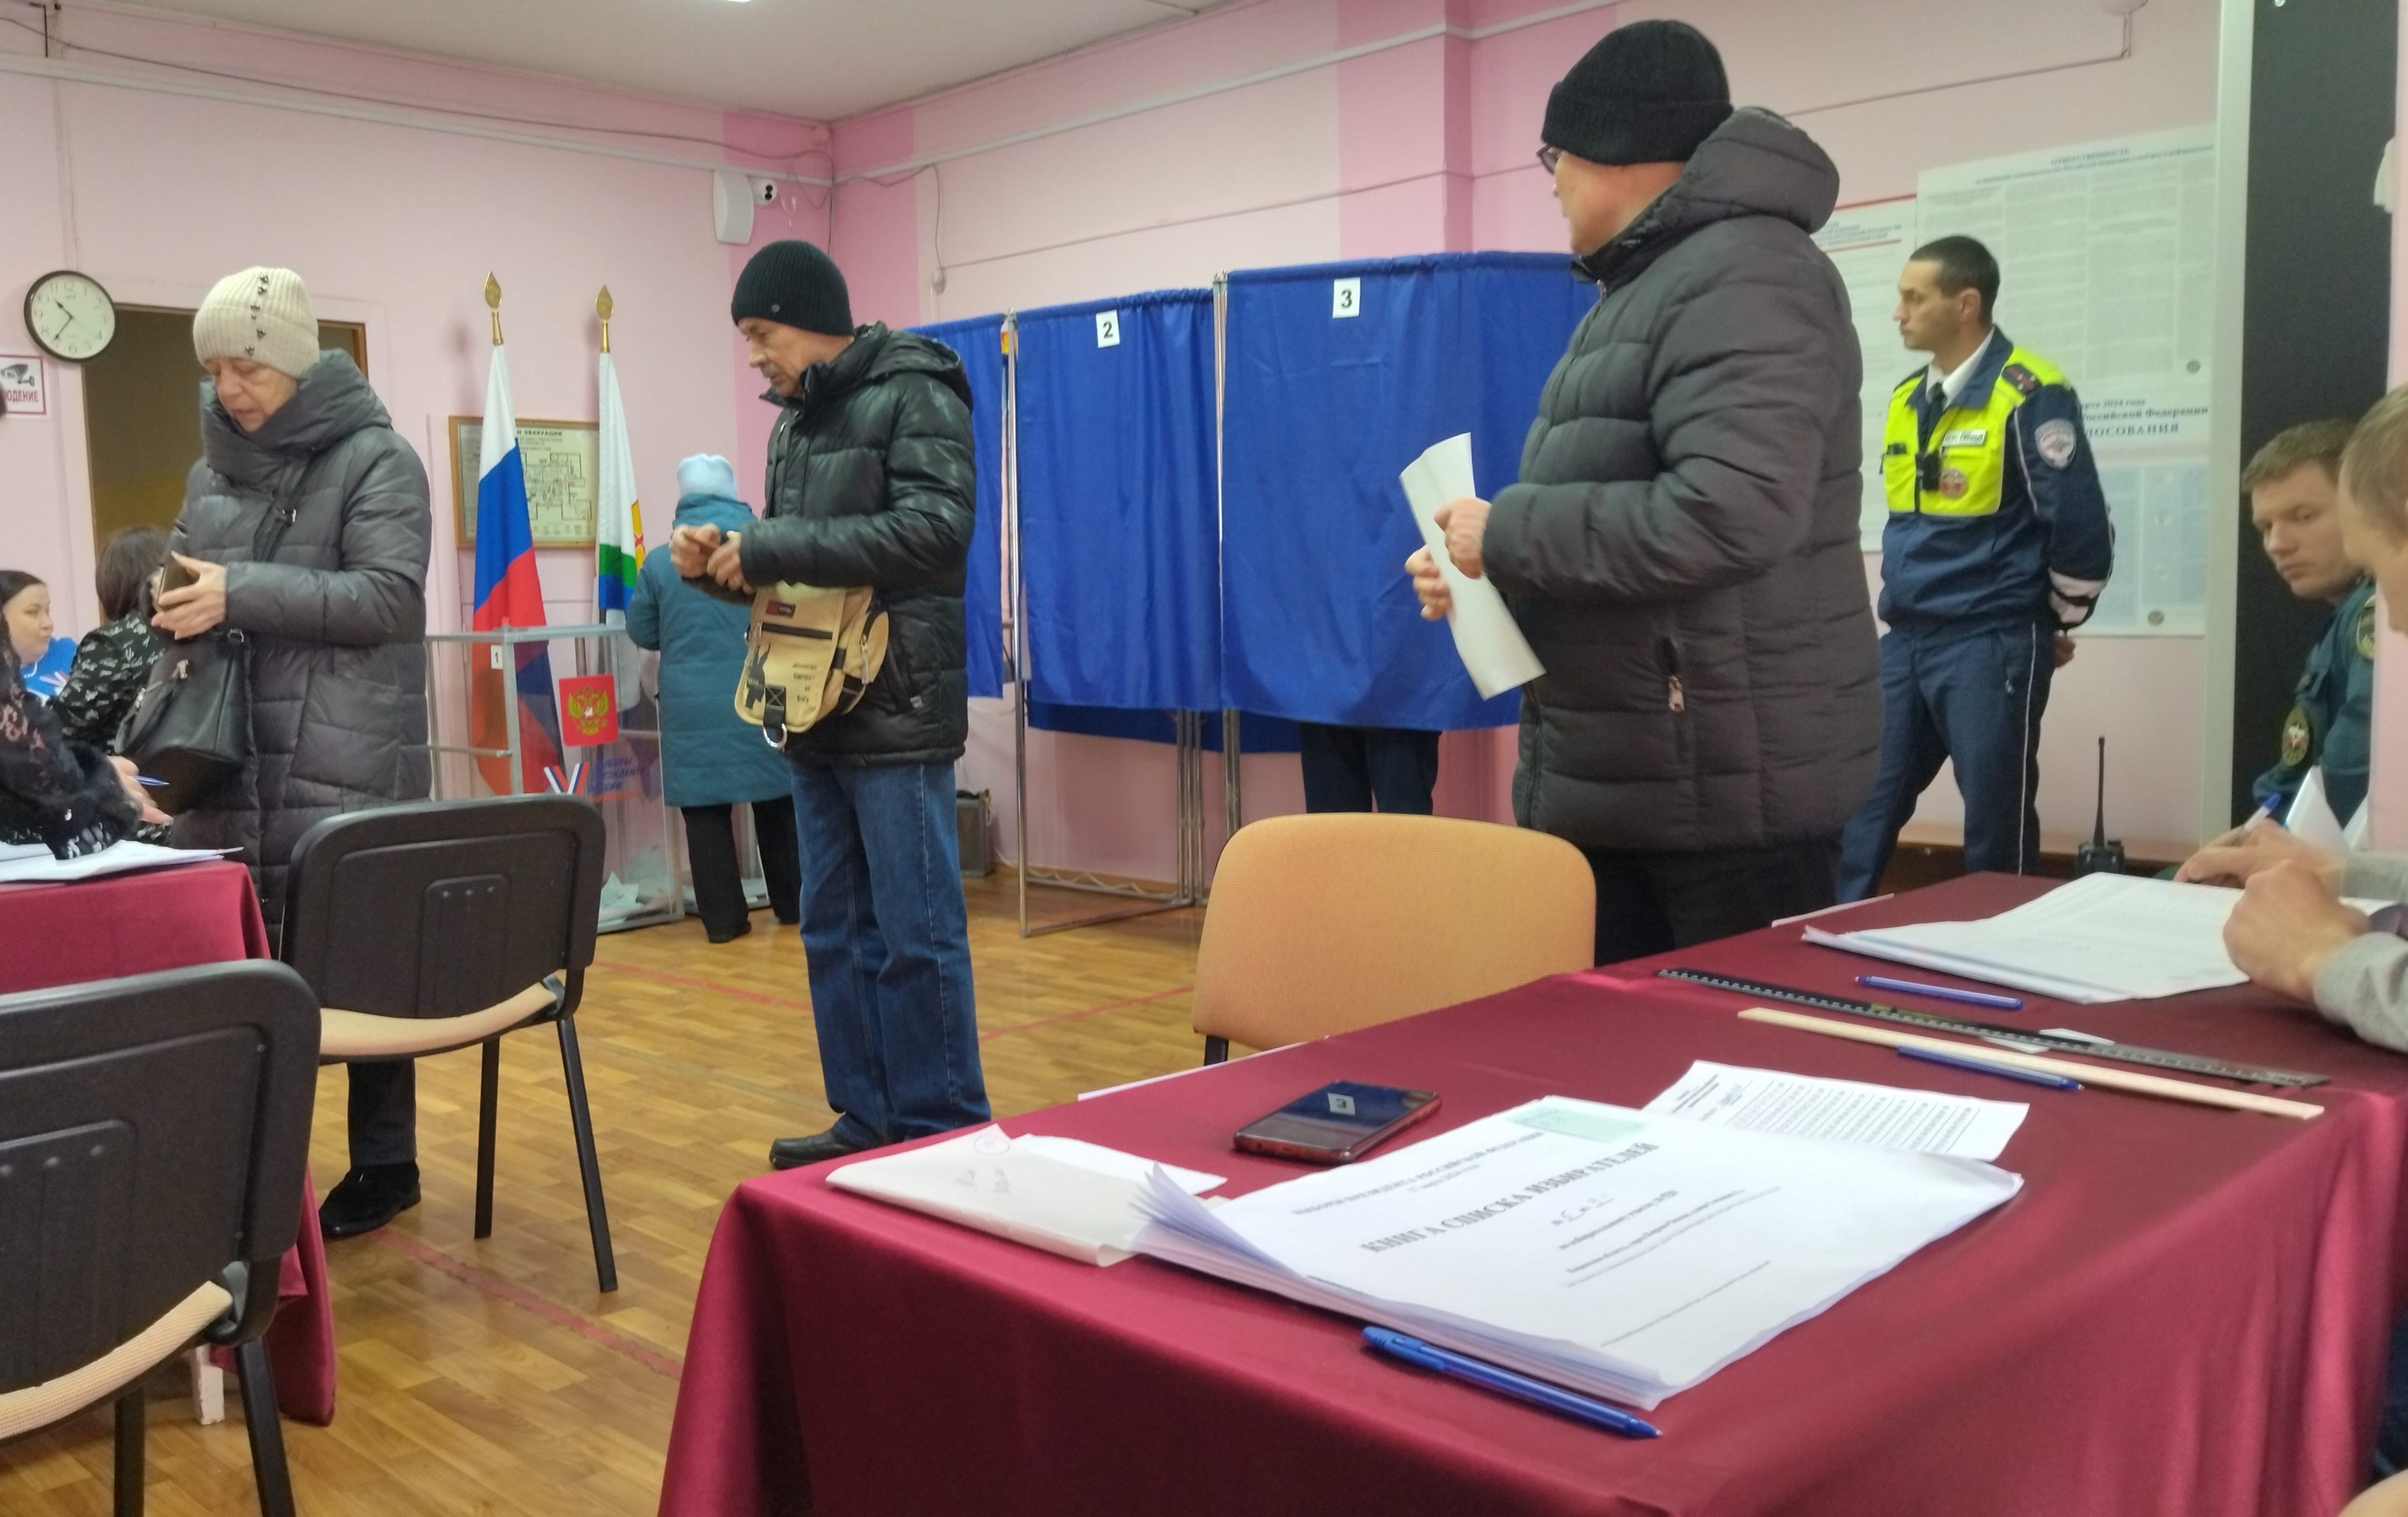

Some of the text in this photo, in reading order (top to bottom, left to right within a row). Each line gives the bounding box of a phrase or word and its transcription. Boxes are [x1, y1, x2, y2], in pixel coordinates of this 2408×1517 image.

[1341, 289, 1353, 309] 3
[1102, 322, 1114, 339] 2
[5, 390, 38, 404] ЮДЕНИЕ
[2086, 423, 2178, 438] ЛОСОВАНИЯ
[495, 652, 499, 663] 1
[1360, 1224, 1446, 1253] КНИГА
[1440, 1193, 1533, 1230] СПИСКА
[1525, 1141, 1660, 1195] ИЗБИРАТЕЛЕЙ
